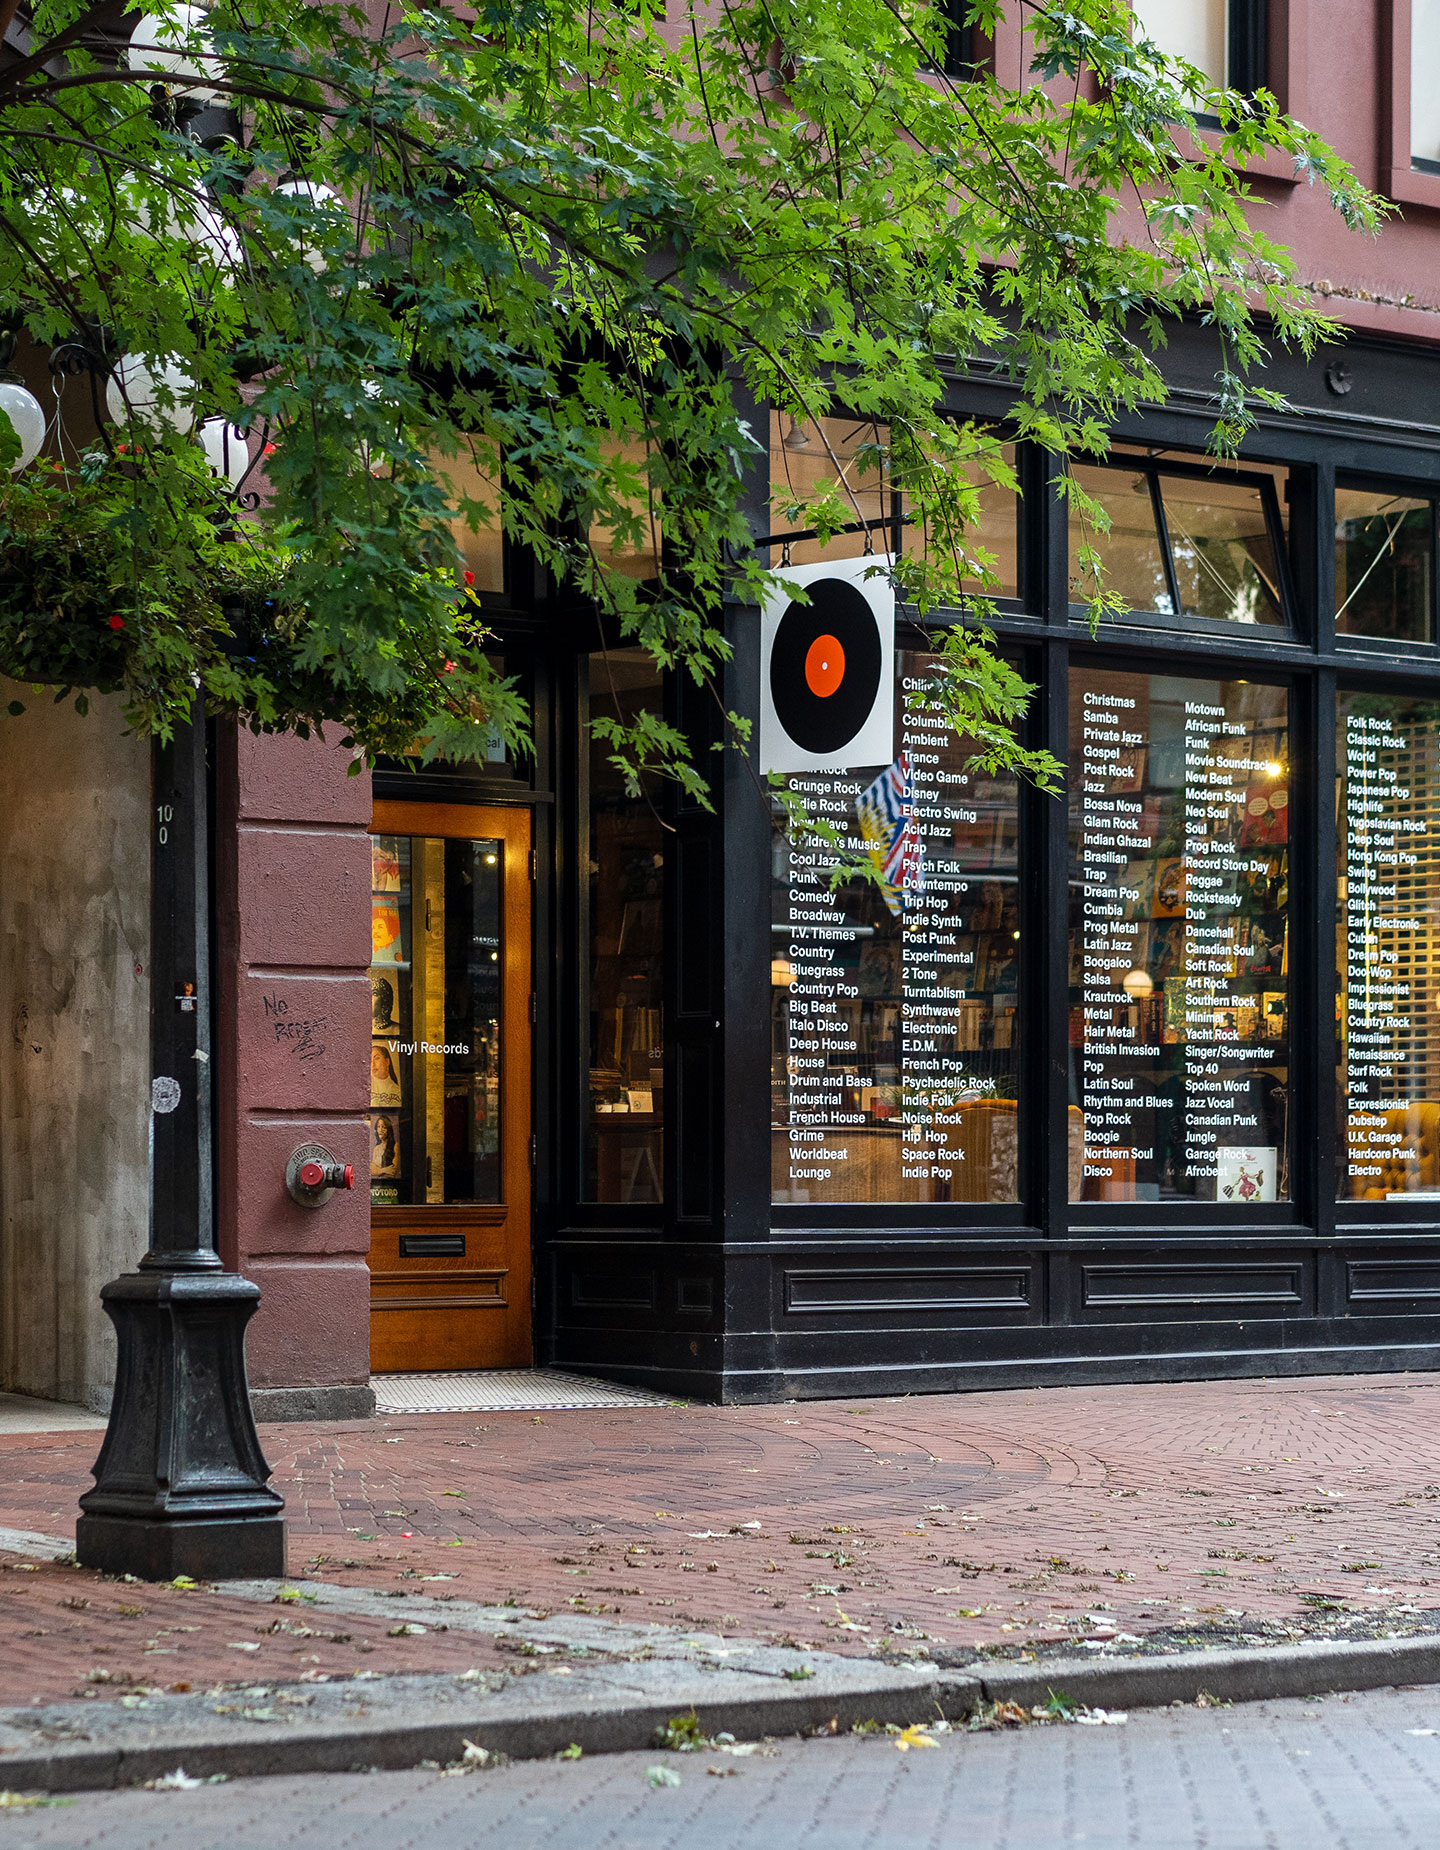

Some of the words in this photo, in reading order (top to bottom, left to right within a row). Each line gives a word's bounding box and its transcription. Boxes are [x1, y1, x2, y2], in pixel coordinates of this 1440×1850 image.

[1084, 693, 1136, 708] Christmas
[1184, 702, 1224, 716] Motown
[1084, 710, 1118, 724] Samba
[1347, 717, 1367, 728] Folk
[1369, 719, 1392, 730] Rock
[1184, 719, 1220, 733] African
[1222, 722, 1246, 735] Funk
[902, 732, 948, 746] Ambient
[1084, 728, 1120, 741] Private
[1120, 731, 1142, 743] Jazz
[1186, 736, 1210, 749] Funk
[1347, 733, 1380, 746] Classic
[1383, 736, 1405, 748] Rock
[902, 750, 940, 766] Trance
[1084, 745, 1120, 760] Gospel
[1347, 750, 1375, 762] World
[900, 767, 934, 782] Video
[936, 771, 968, 784] Game
[1347, 767, 1377, 779] Power
[1379, 769, 1396, 781] Pop
[788, 779, 832, 795] Grunge
[834, 782, 862, 794] Rock
[1084, 780, 1104, 792] Jazz
[1186, 788, 1224, 801] Modern
[1224, 790, 1246, 803] Soul
[1084, 798, 1114, 810] Bossa
[1116, 800, 1142, 812] Nova
[1186, 805, 1206, 817] Neo
[1206, 806, 1228, 818] Soul
[1347, 800, 1383, 813] Highlife
[157, 804, 173, 823] 10
[902, 804, 942, 818] Electro
[944, 807, 976, 823] Swing
[902, 822, 926, 835] Acid
[928, 824, 952, 836] Jazz
[1084, 815, 1110, 828] Glam
[1112, 817, 1138, 829] Rock
[1186, 822, 1206, 834] Soul
[1347, 817, 1401, 830] Yugoslavian
[1403, 820, 1426, 832] Rock
[158, 826, 168, 844] 0
[1084, 833, 1114, 845] Indian
[1116, 835, 1152, 848] Ghazal
[1347, 833, 1372, 846] Deep
[1374, 835, 1394, 846] Soul
[902, 840, 926, 855] Trap
[1186, 839, 1210, 854] Prog
[1210, 841, 1236, 853] Rock
[1347, 850, 1372, 862] Hong
[1374, 851, 1397, 864] Kong
[1399, 853, 1417, 865] Pop
[902, 857, 934, 874] Psych
[938, 861, 960, 873] Folk
[790, 870, 818, 883] Punk
[1084, 868, 1106, 882] Trap
[1186, 874, 1222, 888] Reggae
[1084, 885, 1118, 898] Dream
[1120, 887, 1140, 901] Pop
[1186, 891, 1242, 907] Rocksteady
[902, 893, 924, 909] Trip
[926, 896, 948, 911] Hop
[1084, 903, 1122, 915] Cumbia
[790, 908, 846, 924] Broadway
[902, 913, 930, 925] Indie
[932, 915, 962, 928] Synth
[1186, 908, 1206, 919] Dub
[788, 926, 810, 938] T.V.
[810, 927, 858, 940] Themes
[1084, 921, 1108, 935] Prog
[1110, 922, 1138, 933] Metal
[1186, 925, 1234, 938] Dancehall
[902, 931, 926, 943] Post
[930, 933, 956, 944] Punk
[1084, 938, 1110, 949] Latin
[1110, 939, 1132, 950] Jazz
[790, 945, 834, 960] Country
[790, 963, 844, 978] Bluegrass
[1186, 959, 1207, 971] Soft
[1208, 960, 1232, 972] Rock
[902, 967, 910, 978] 2
[910, 968, 938, 979] Tone
[1084, 973, 1110, 984] Salsa
[1184, 977, 1202, 988] Art
[1204, 977, 1228, 989] Rock
[902, 985, 966, 998] Turntablism
[1084, 990, 1134, 1003] Krautrock
[790, 1000, 808, 1015] Big
[812, 1001, 836, 1013] Beat
[902, 1003, 960, 1017] Synthwave
[1084, 1008, 1112, 1019] Metal
[790, 1019, 814, 1030] Italo
[816, 1020, 848, 1031] Disco
[902, 1022, 958, 1034] Electronic
[1084, 1025, 1106, 1036] Hair
[1106, 1026, 1136, 1037] Metal
[790, 1037, 820, 1051] Deep
[822, 1038, 856, 1050] House
[1348, 1033, 1390, 1044] Hawaiian
[388, 1041, 418, 1055] Vinyl
[420, 1042, 468, 1054] Records
[1084, 1043, 1116, 1054] British
[1118, 1044, 1160, 1055] Invasion
[1186, 1045, 1274, 1060] Singer/Songwriter
[1348, 1050, 1405, 1060] Renaissance
[788, 1056, 824, 1067] House
[902, 1058, 940, 1069] French
[942, 1059, 962, 1073] Pop
[1184, 1063, 1204, 1076] Top
[1204, 1063, 1218, 1074] 40
[1348, 1066, 1367, 1076] Surf
[1369, 1066, 1392, 1076] Rock
[902, 1076, 966, 1090] Psychedelic
[968, 1077, 996, 1090] Rock
[1084, 1078, 1110, 1089] Latin
[1112, 1078, 1134, 1089] Soul
[1186, 1080, 1222, 1093] Spoken
[1222, 1080, 1250, 1091] Word
[1348, 1082, 1368, 1093] Folk
[790, 1093, 842, 1105] Industrial
[902, 1093, 930, 1105] Indie
[932, 1094, 954, 1106] Folk
[1084, 1096, 1122, 1109] Rhythm
[1124, 1096, 1144, 1107] and
[1146, 1096, 1174, 1107] Blues
[1184, 1097, 1206, 1107] Jazz
[1206, 1097, 1234, 1108] Vocal
[1348, 1099, 1409, 1110] Expressionist
[788, 1111, 828, 1125] French
[830, 1111, 866, 1123] House
[900, 1112, 932, 1123] Noise
[936, 1113, 962, 1124] Rock
[1084, 1113, 1104, 1126] Pop
[1106, 1113, 1132, 1124] Rock
[790, 1128, 824, 1141] Grime
[902, 1130, 922, 1144] Hip
[926, 1131, 948, 1144] Hop
[1084, 1130, 1120, 1144] Boogie
[1184, 1131, 1216, 1144] Jungle
[1348, 1132, 1366, 1142] U.K.
[1368, 1132, 1402, 1144] Garage
[790, 1148, 848, 1159] Worldbeat
[790, 1166, 832, 1180] Lounge
[902, 1166, 928, 1177] Indie
[932, 1167, 952, 1180] Pop
[1084, 1165, 1112, 1176] Disco
